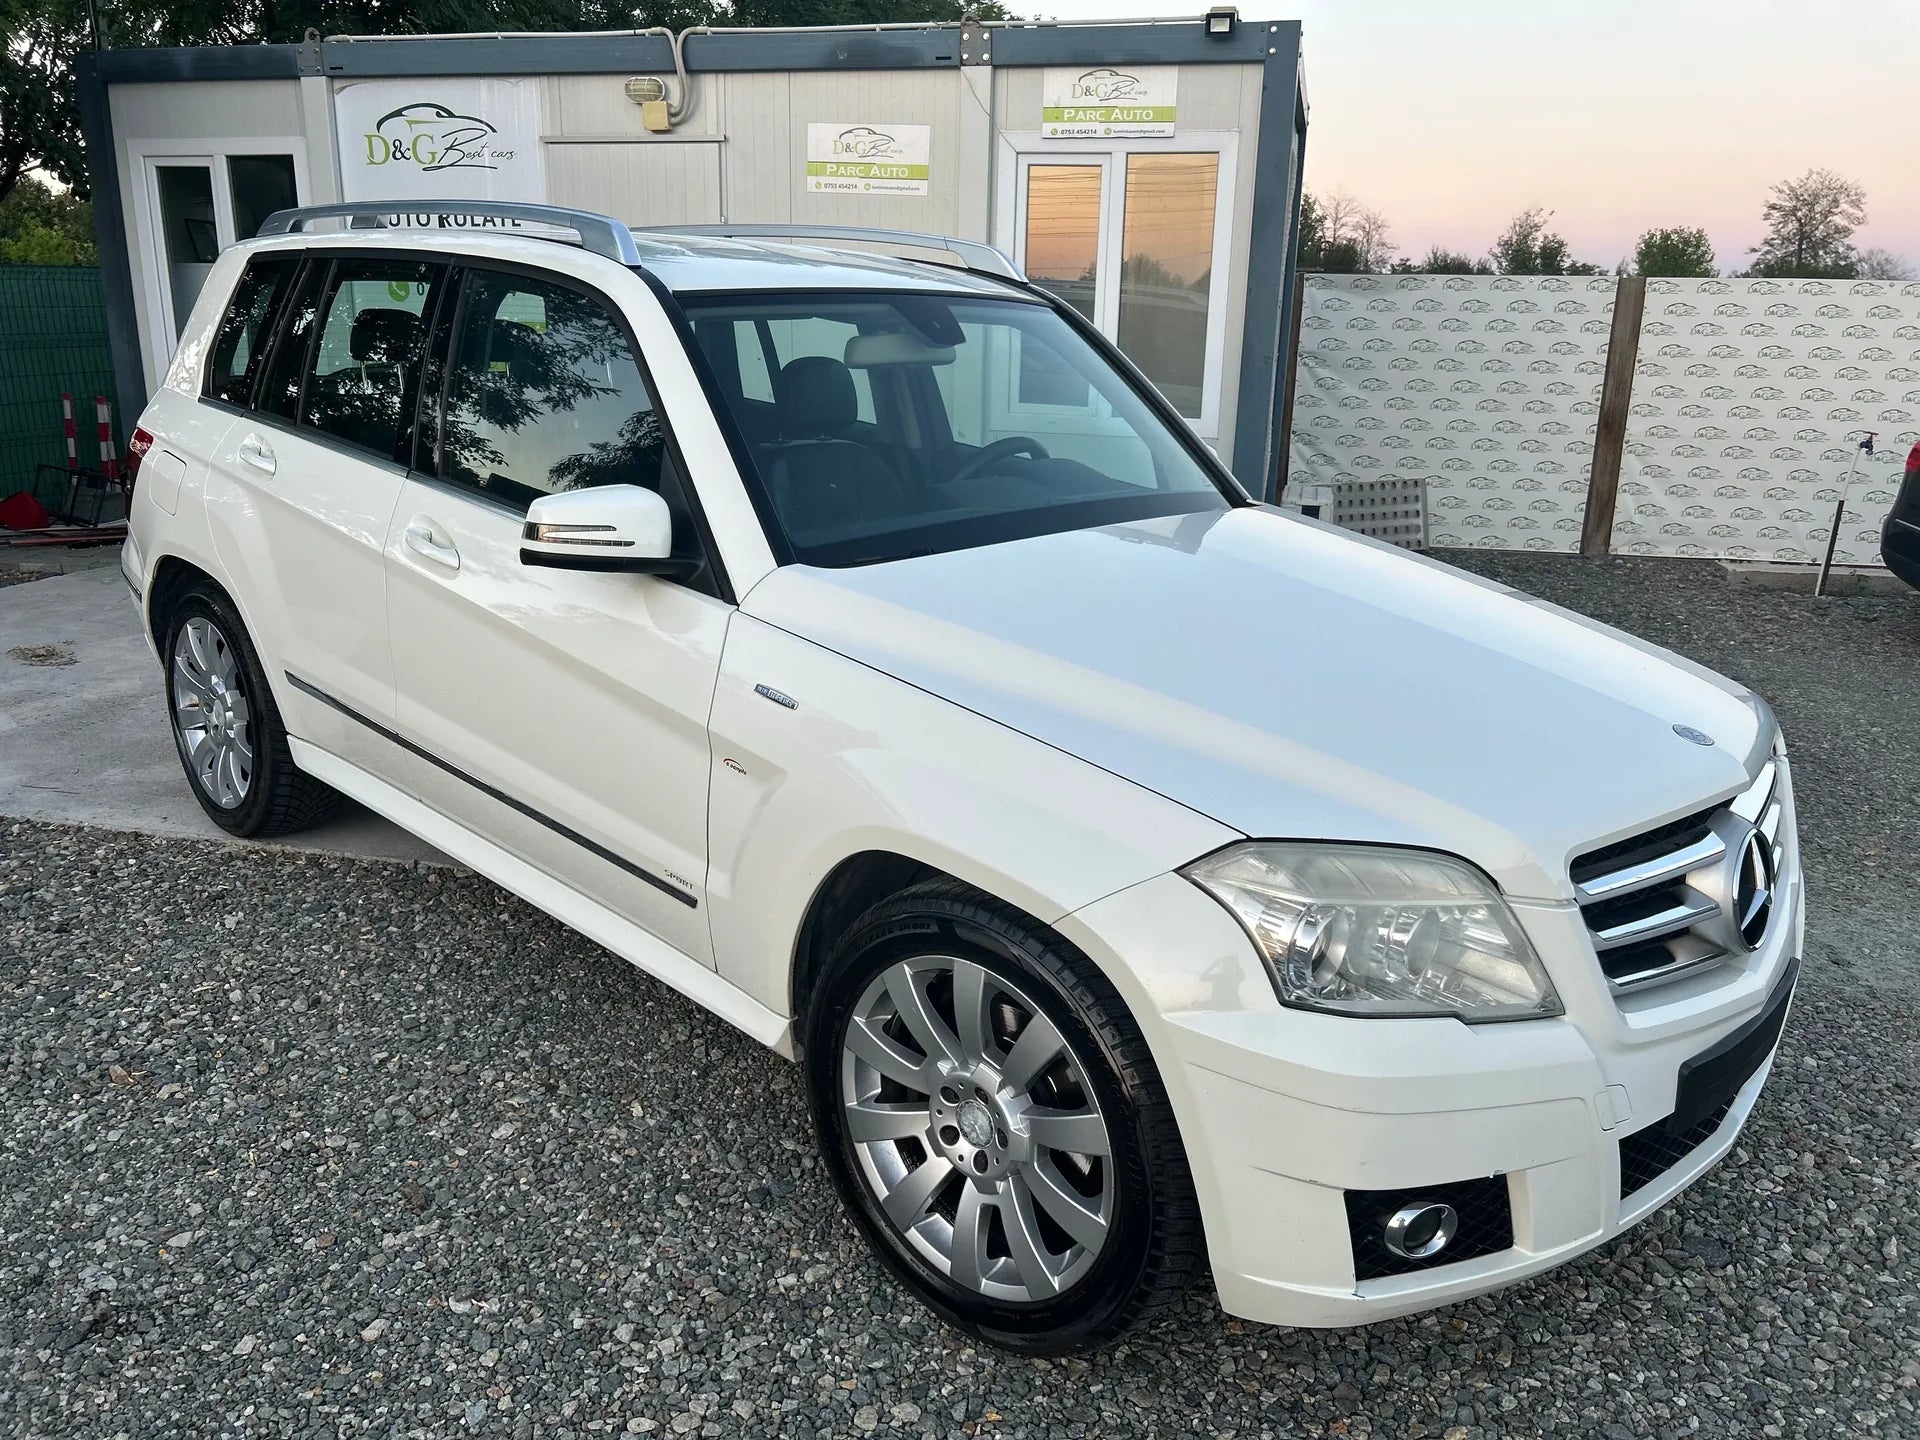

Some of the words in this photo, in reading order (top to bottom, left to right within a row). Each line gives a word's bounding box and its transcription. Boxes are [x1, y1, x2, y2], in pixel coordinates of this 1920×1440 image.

[1071, 83, 1108, 99] D&G
[1063, 109, 1106, 121] PARC
[1110, 109, 1153, 121] AUTO
[363, 133, 438, 166] D&G
[832, 140, 867, 155] D&G
[826, 164, 865, 177] PARC
[869, 165, 909, 178] AUTO
